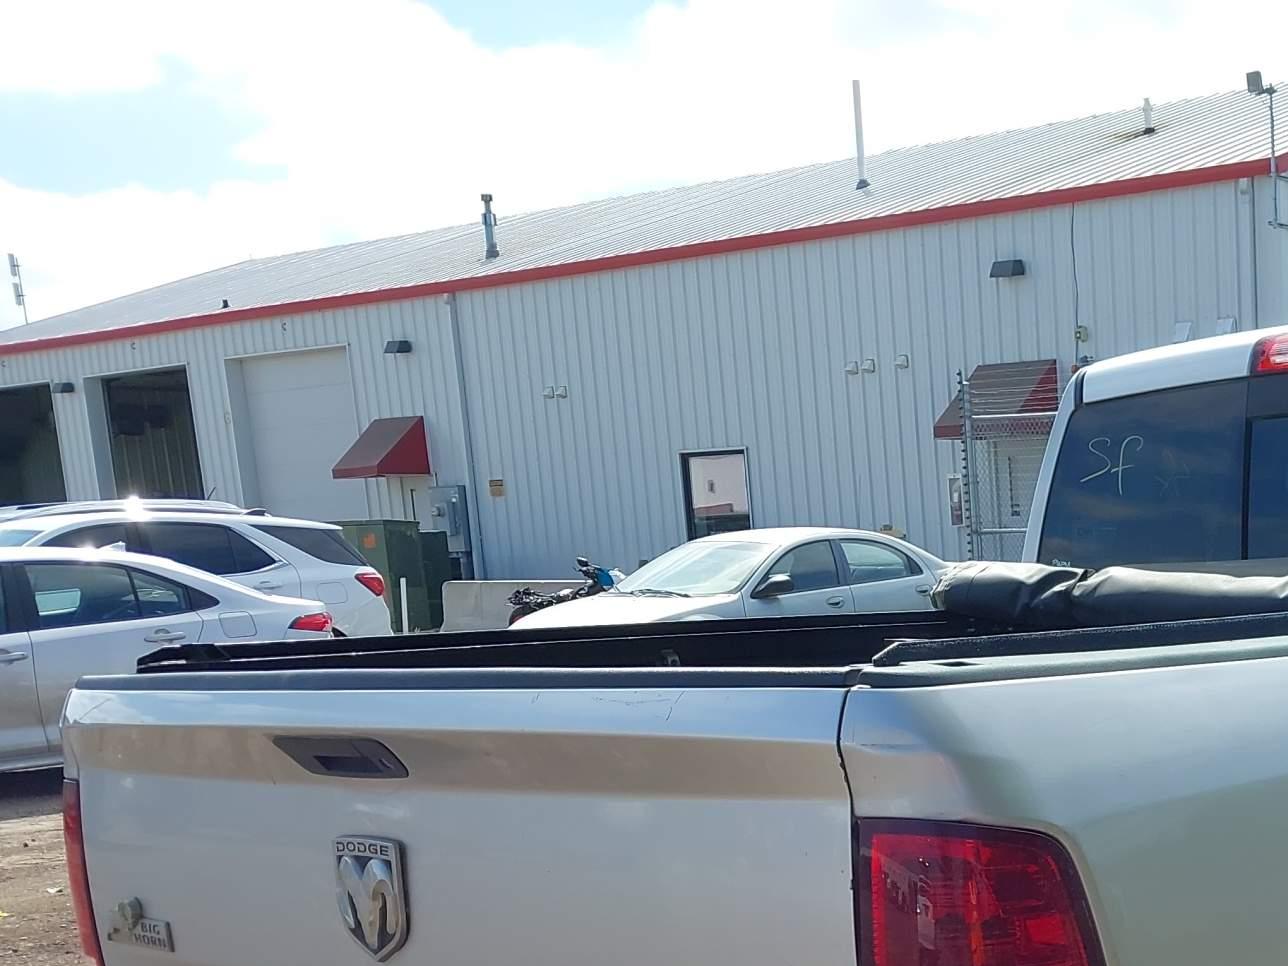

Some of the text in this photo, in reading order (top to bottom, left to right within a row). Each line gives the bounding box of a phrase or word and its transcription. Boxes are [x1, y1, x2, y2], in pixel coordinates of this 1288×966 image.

[336, 841, 389, 857] DODGE
[141, 922, 160, 935] BIG
[134, 933, 168, 949] HORN
